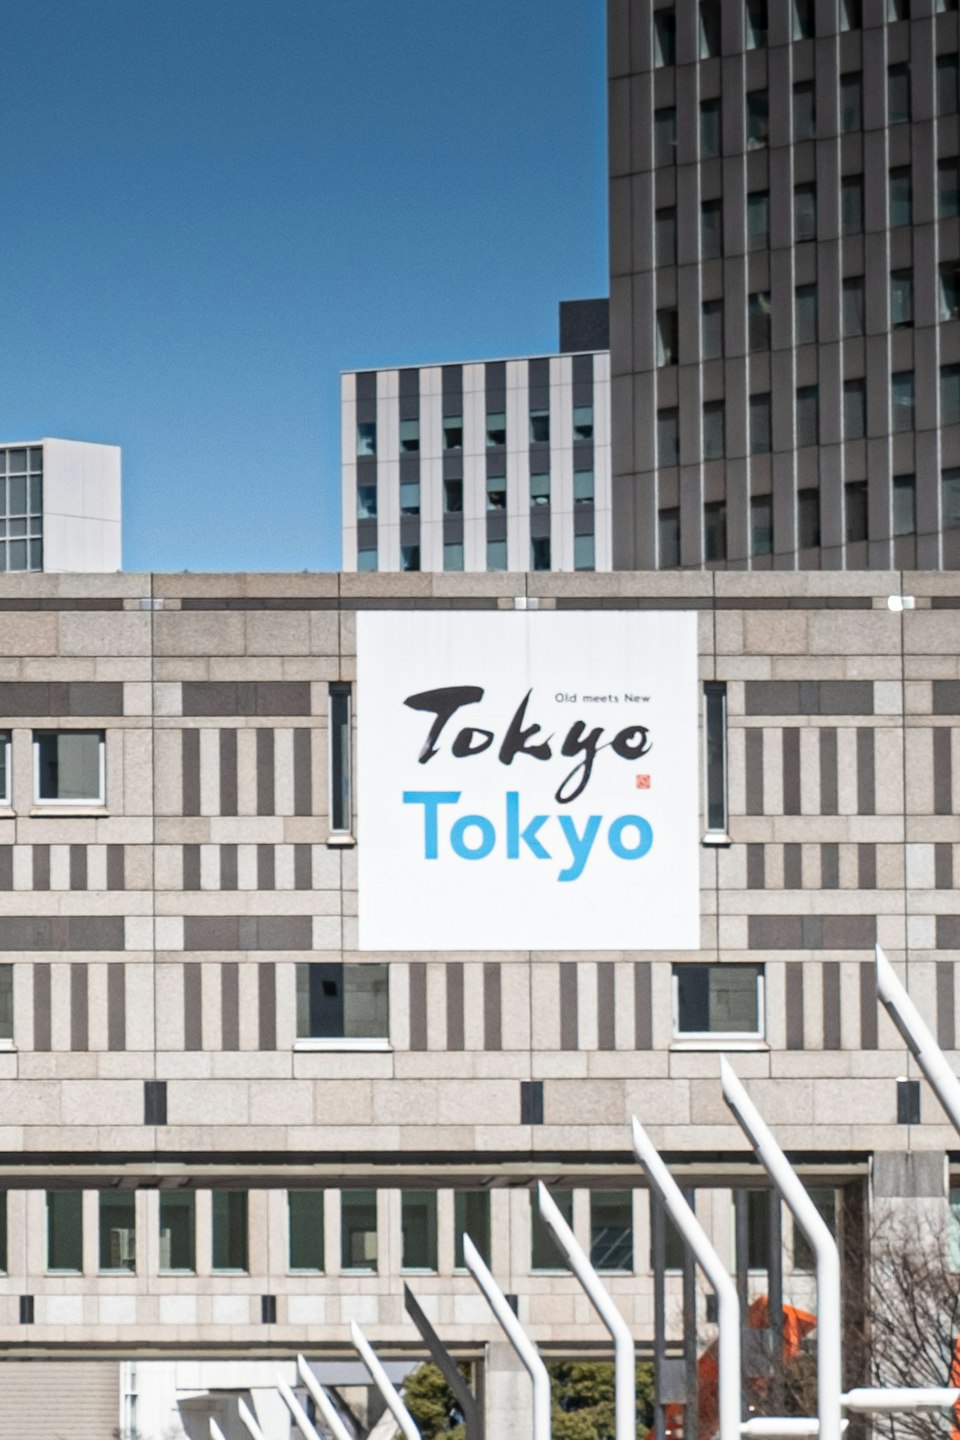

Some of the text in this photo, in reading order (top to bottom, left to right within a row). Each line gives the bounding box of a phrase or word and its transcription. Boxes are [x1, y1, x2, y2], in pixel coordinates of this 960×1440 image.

[555, 693, 651, 703] Old meets New
[403, 685, 653, 804] Tokyo
[402, 791, 653, 882] Tokyo
